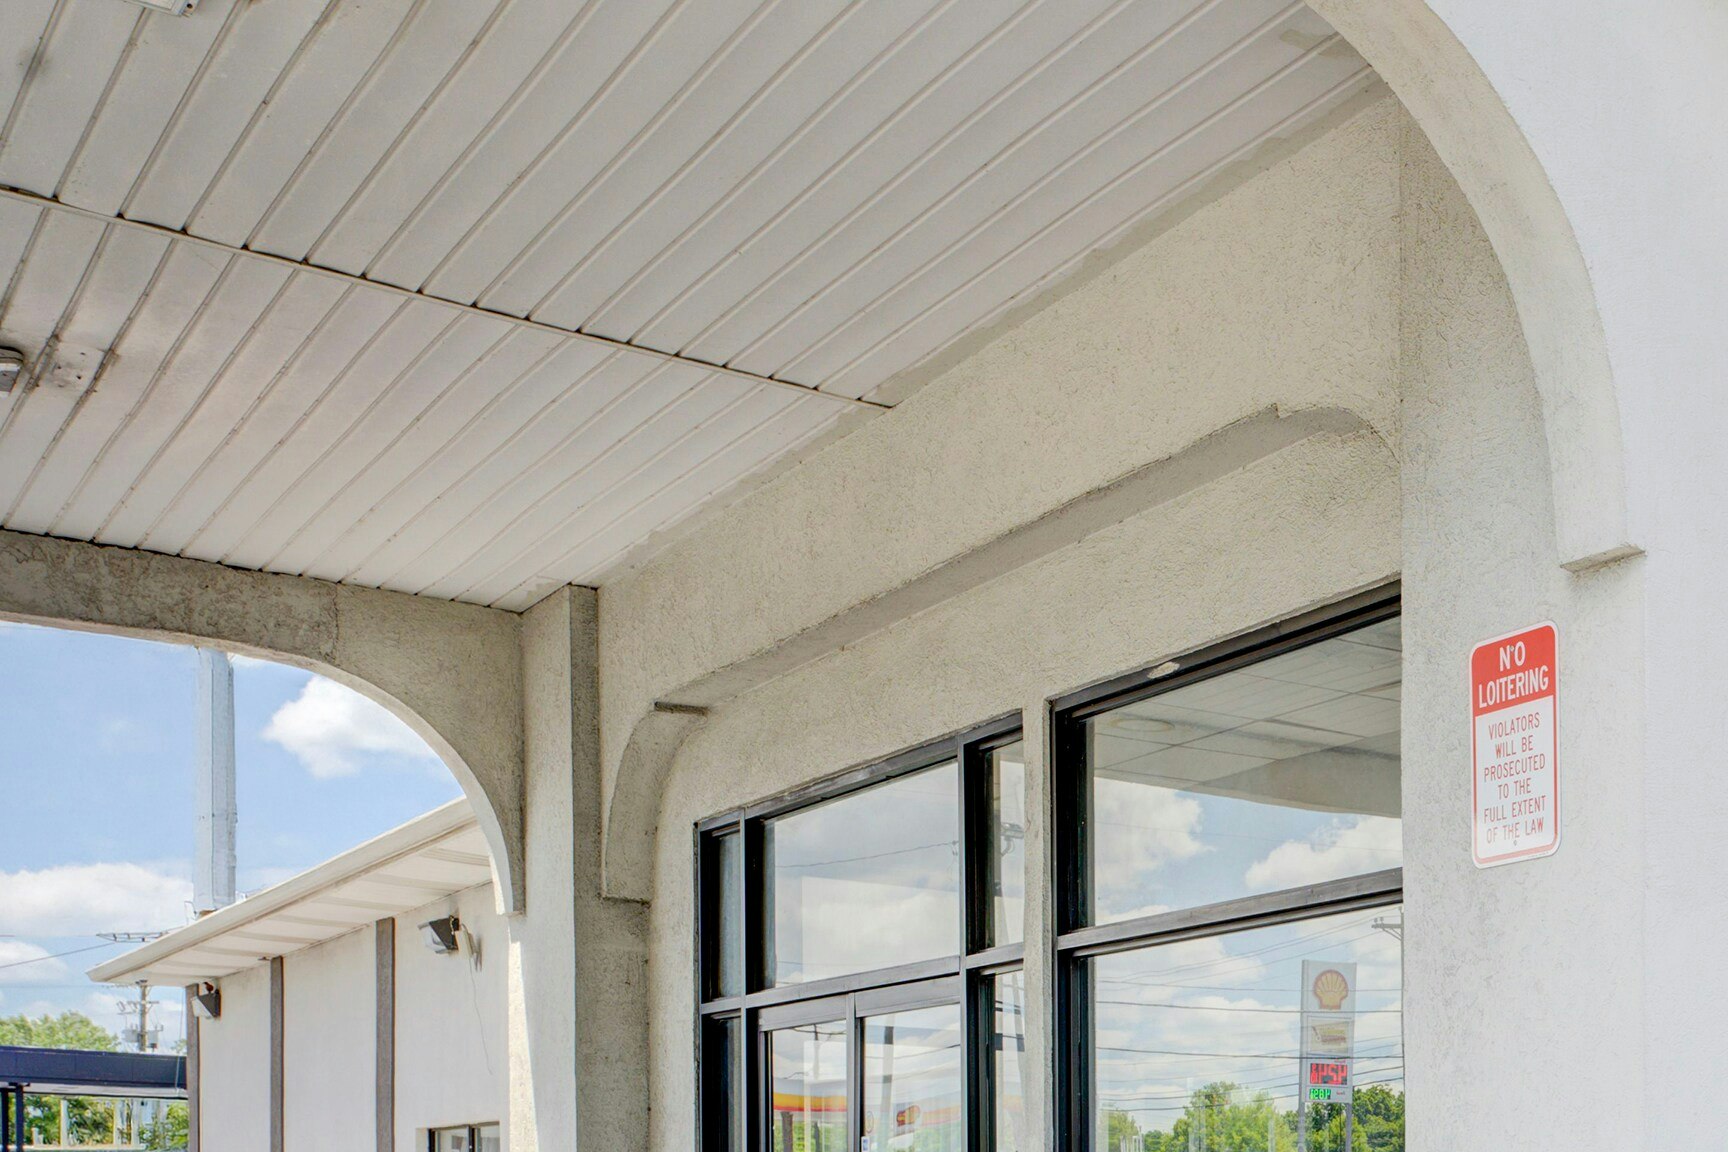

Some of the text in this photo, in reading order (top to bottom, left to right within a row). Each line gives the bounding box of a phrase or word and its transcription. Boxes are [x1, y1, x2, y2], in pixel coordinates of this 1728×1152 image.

[1500, 641, 1526, 672] NO
[1478, 665, 1549, 709] LOITERING
[1488, 712, 1540, 740] VIOLATORS
[1495, 735, 1534, 759] WILL BE
[1484, 753, 1546, 783] PROSECUTED
[1498, 778, 1532, 800] TO THE
[1484, 795, 1547, 824] FULL EXTENT
[1486, 817, 1545, 844] OF THE LAW
